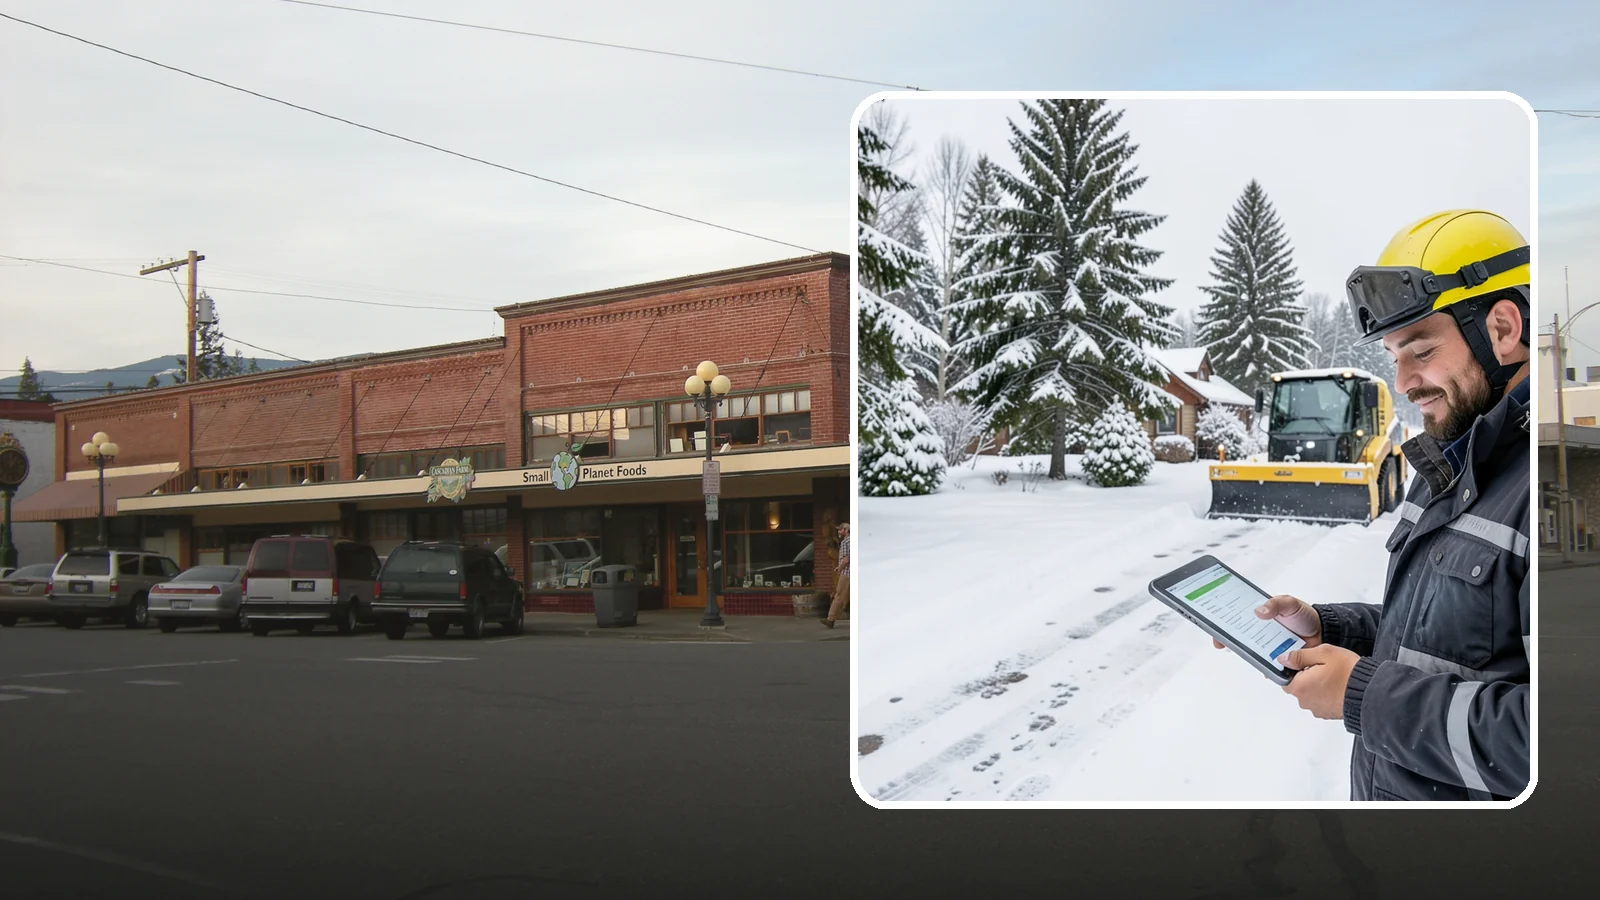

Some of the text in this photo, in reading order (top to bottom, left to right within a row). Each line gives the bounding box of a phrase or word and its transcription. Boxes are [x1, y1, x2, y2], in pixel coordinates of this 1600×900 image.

[456, 465, 469, 474] FARM
[523, 464, 647, 483] Small Planet Foods
